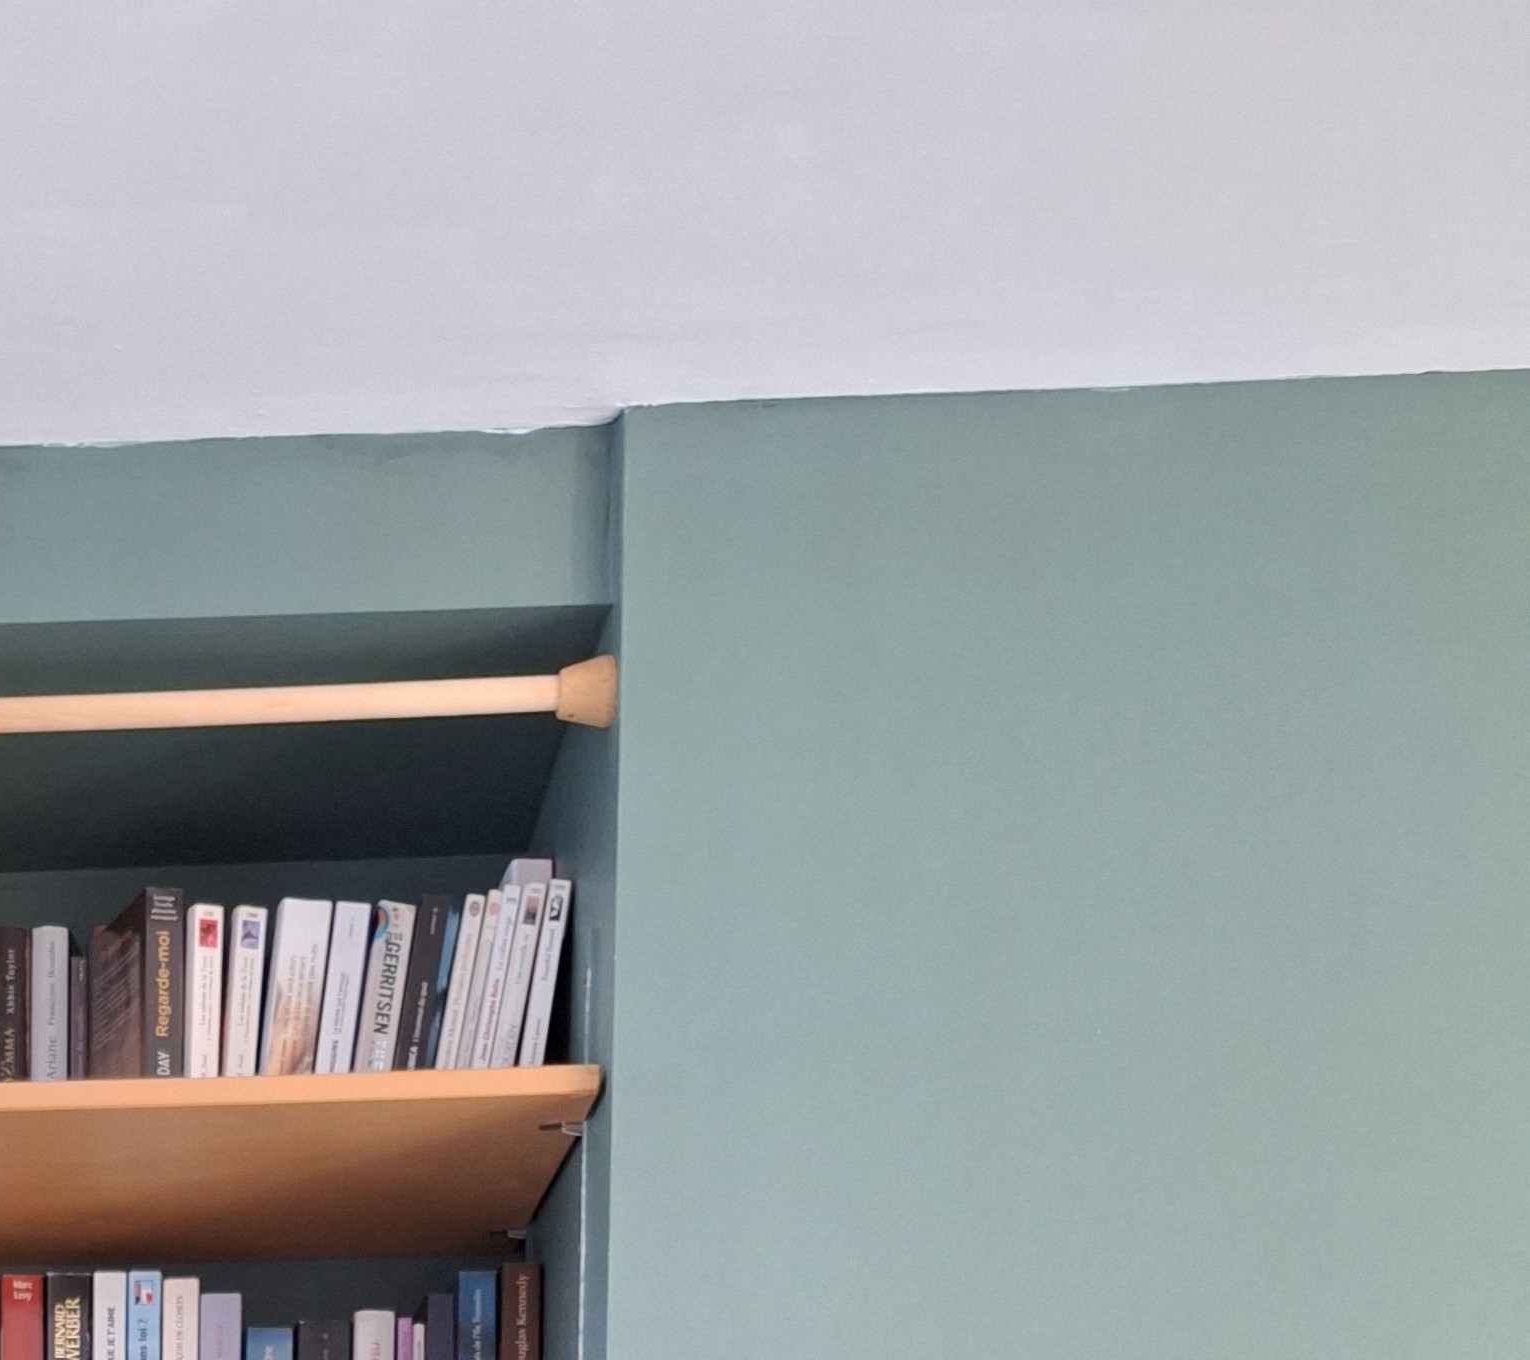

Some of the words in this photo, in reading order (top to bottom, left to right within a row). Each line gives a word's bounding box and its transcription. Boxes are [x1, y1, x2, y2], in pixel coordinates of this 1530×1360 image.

[155, 930, 172, 1037] Regarde-moi
[372, 938, 402, 1035] GERRITSEN
[156, 1051, 170, 1076] DAY
[516, 1273, 530, 1326] Kennedy
[53, 1304, 66, 1359] BERNARD
[106, 1336, 116, 1347] JE
[136, 1327, 148, 1342] toi
